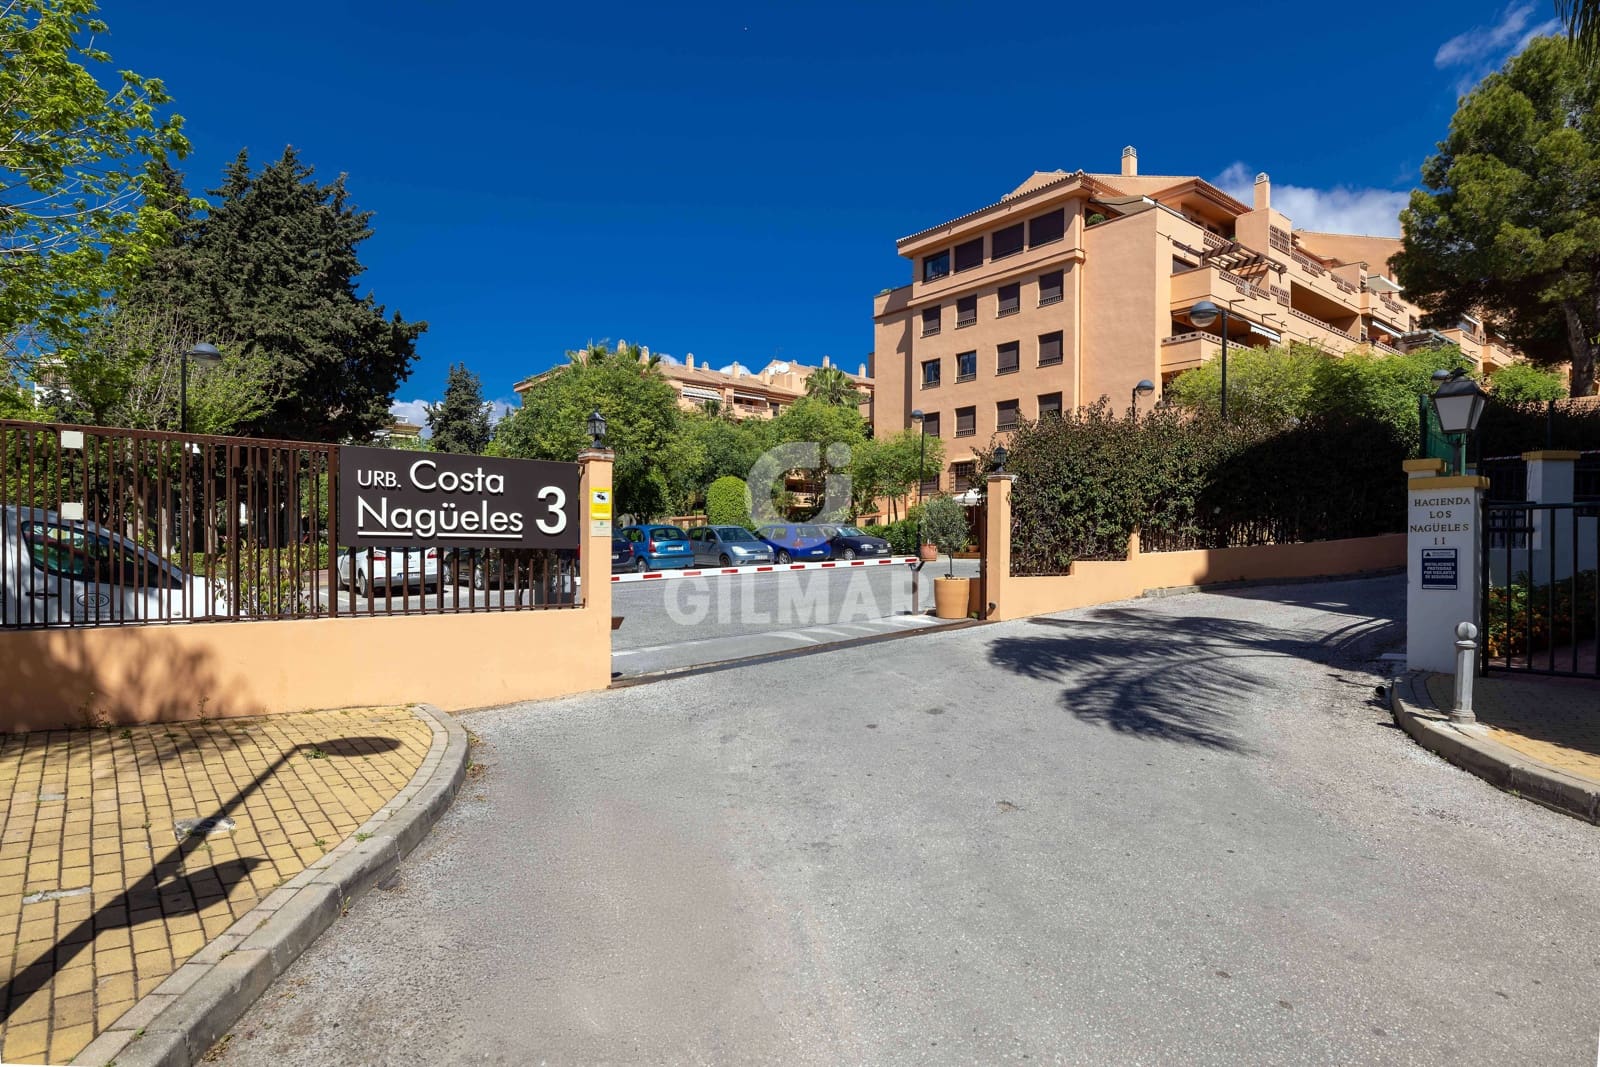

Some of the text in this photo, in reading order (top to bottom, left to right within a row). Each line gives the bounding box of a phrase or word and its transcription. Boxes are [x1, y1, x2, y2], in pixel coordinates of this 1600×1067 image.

[357, 459, 505, 494] URB. Costa
[357, 496, 523, 538] Nagüeles
[535, 486, 568, 535] 3
[1414, 497, 1471, 507] HACIENDA
[1429, 511, 1452, 519] LOS
